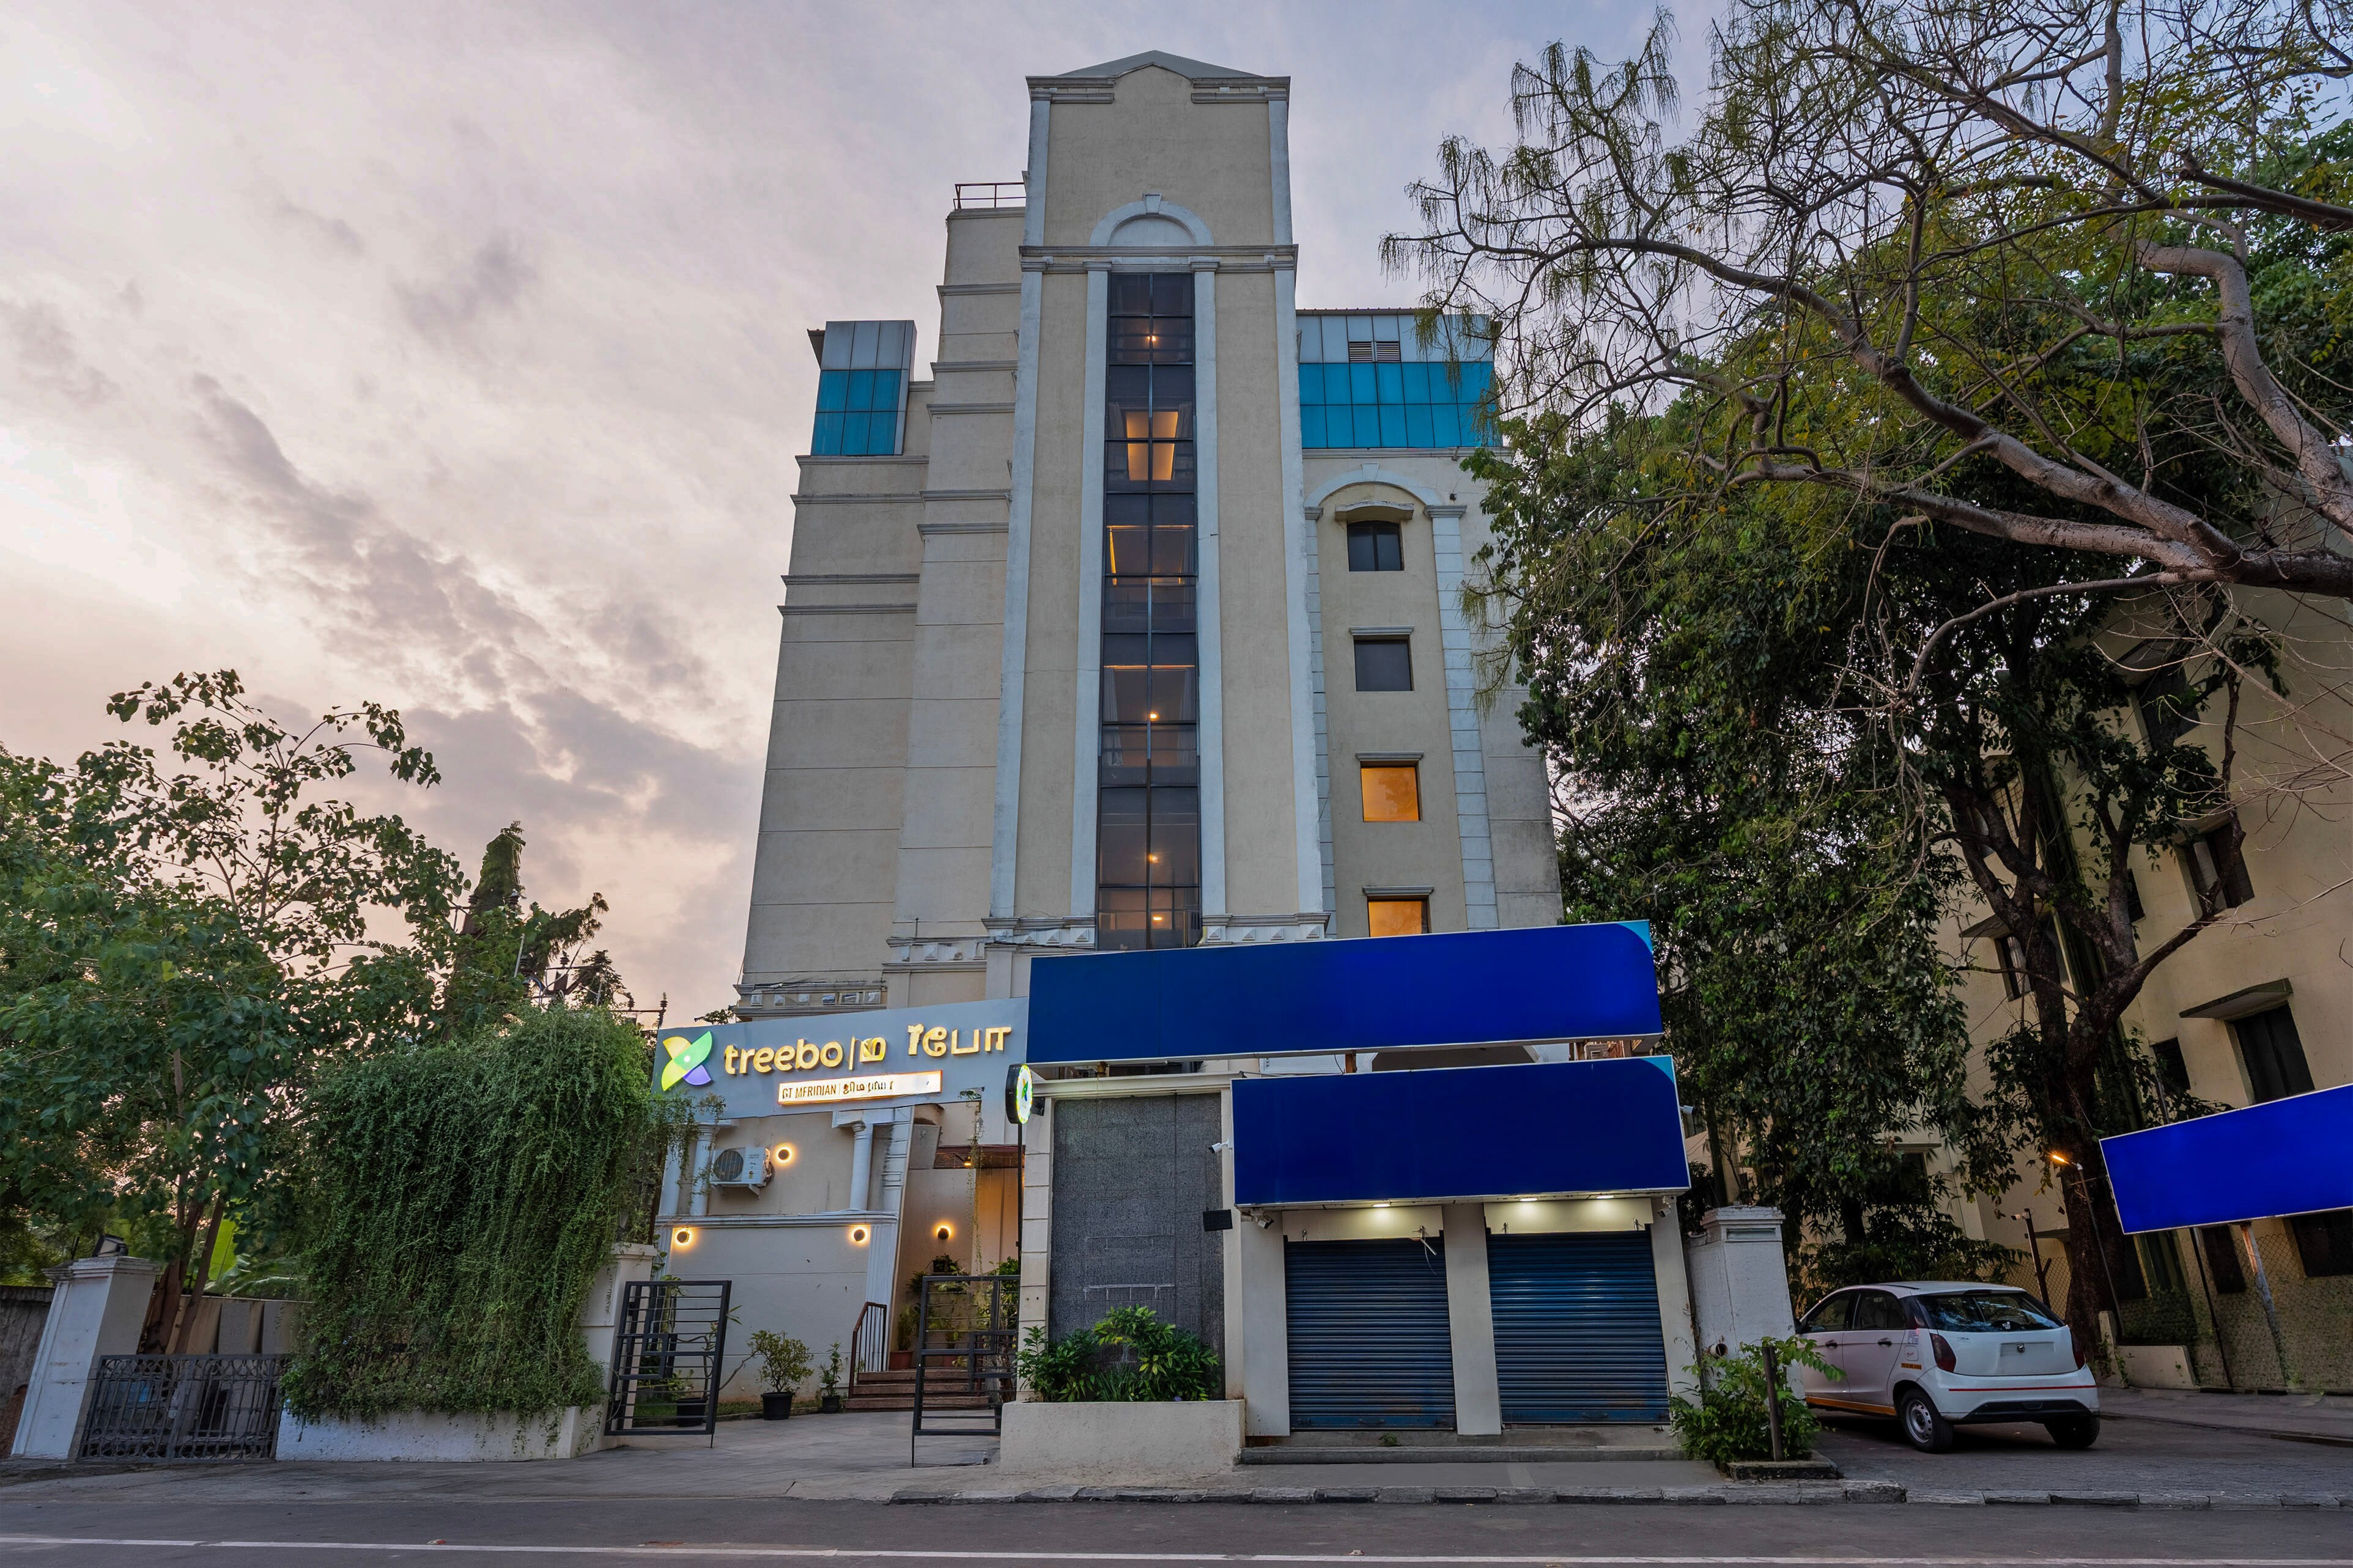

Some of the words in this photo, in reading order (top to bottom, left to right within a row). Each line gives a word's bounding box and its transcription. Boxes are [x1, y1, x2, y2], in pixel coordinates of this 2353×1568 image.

[723, 1038, 843, 1075] treebo
[782, 1088, 793, 1099] GT
[795, 1084, 837, 1099] MERIDIAN
